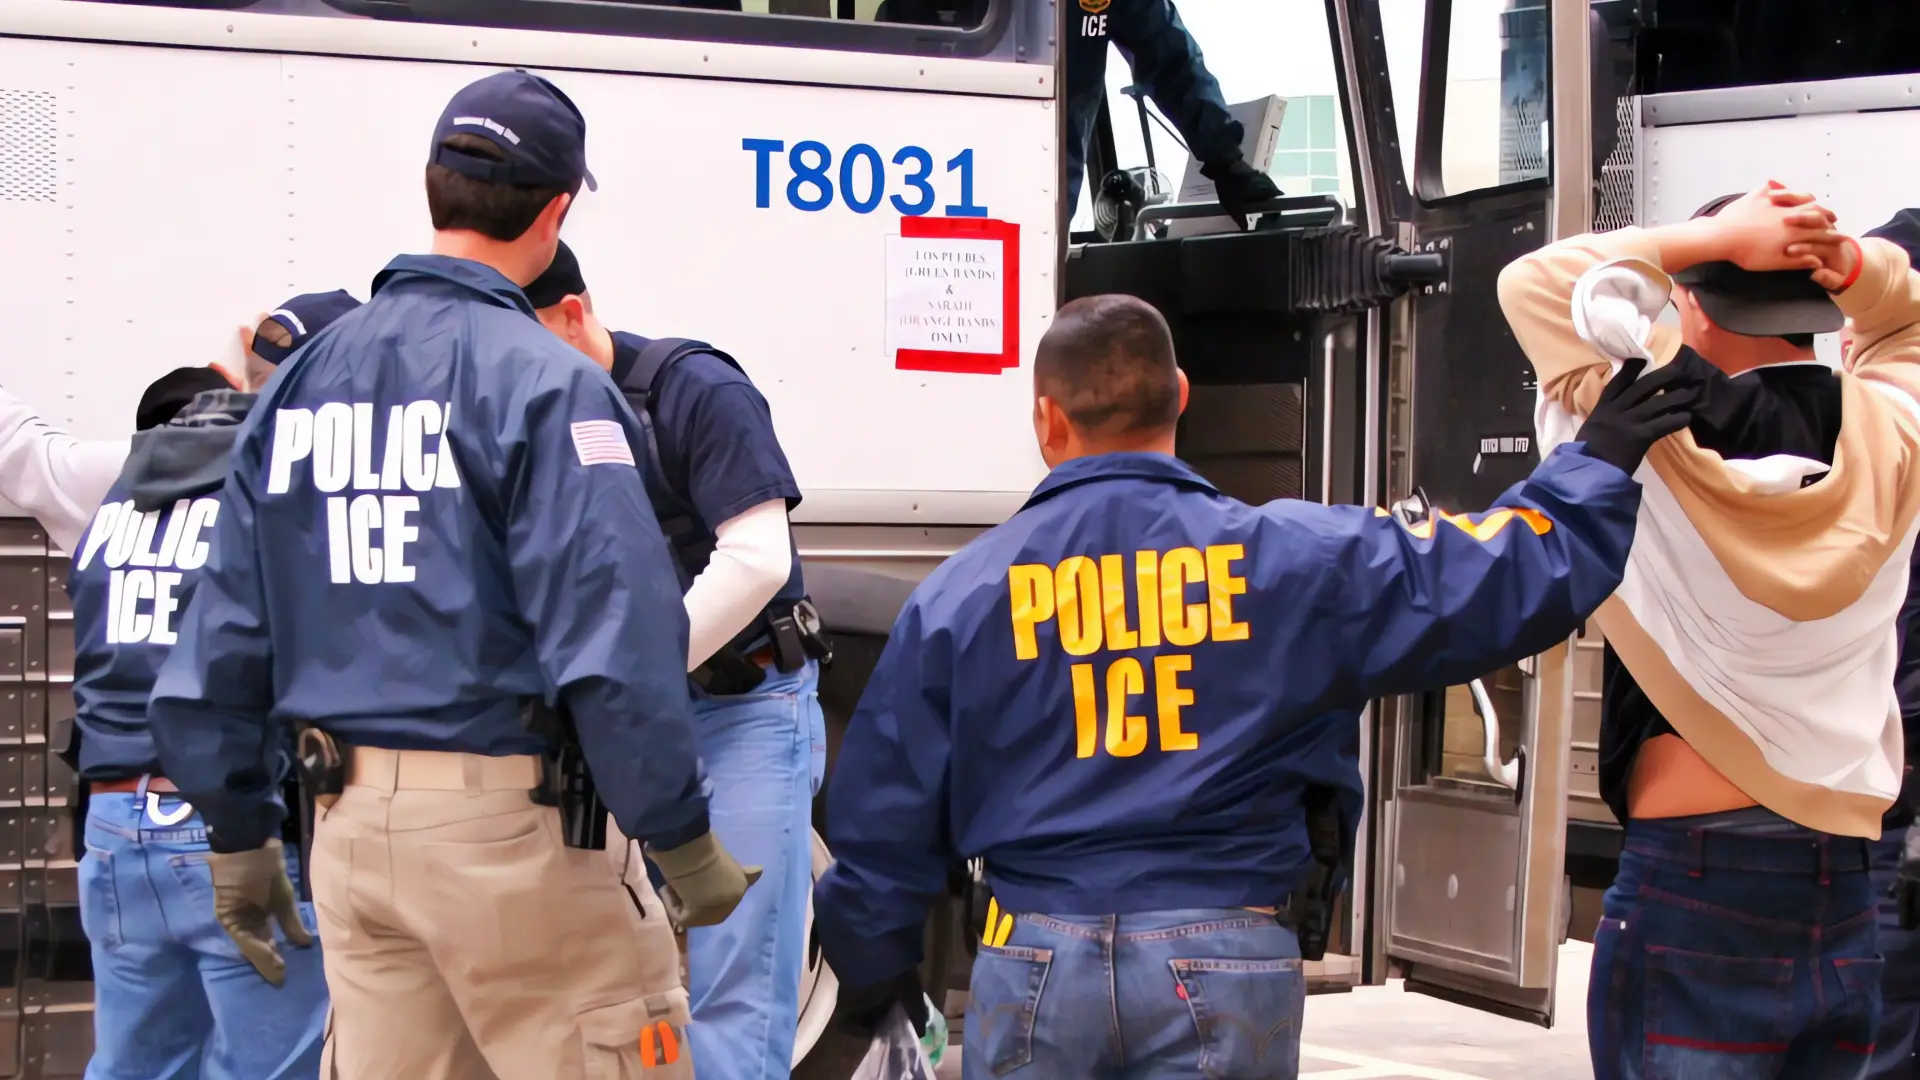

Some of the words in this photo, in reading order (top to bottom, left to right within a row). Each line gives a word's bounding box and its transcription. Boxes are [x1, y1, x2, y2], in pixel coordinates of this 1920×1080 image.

[1081, 14, 1108, 37] ICE
[742, 138, 988, 217] T8031
[945, 284, 954, 295] &
[326, 494, 420, 585] ICE
[106, 569, 183, 645] ICE
[1008, 543, 1250, 660] POLICE
[1070, 654, 1198, 759] ICE
